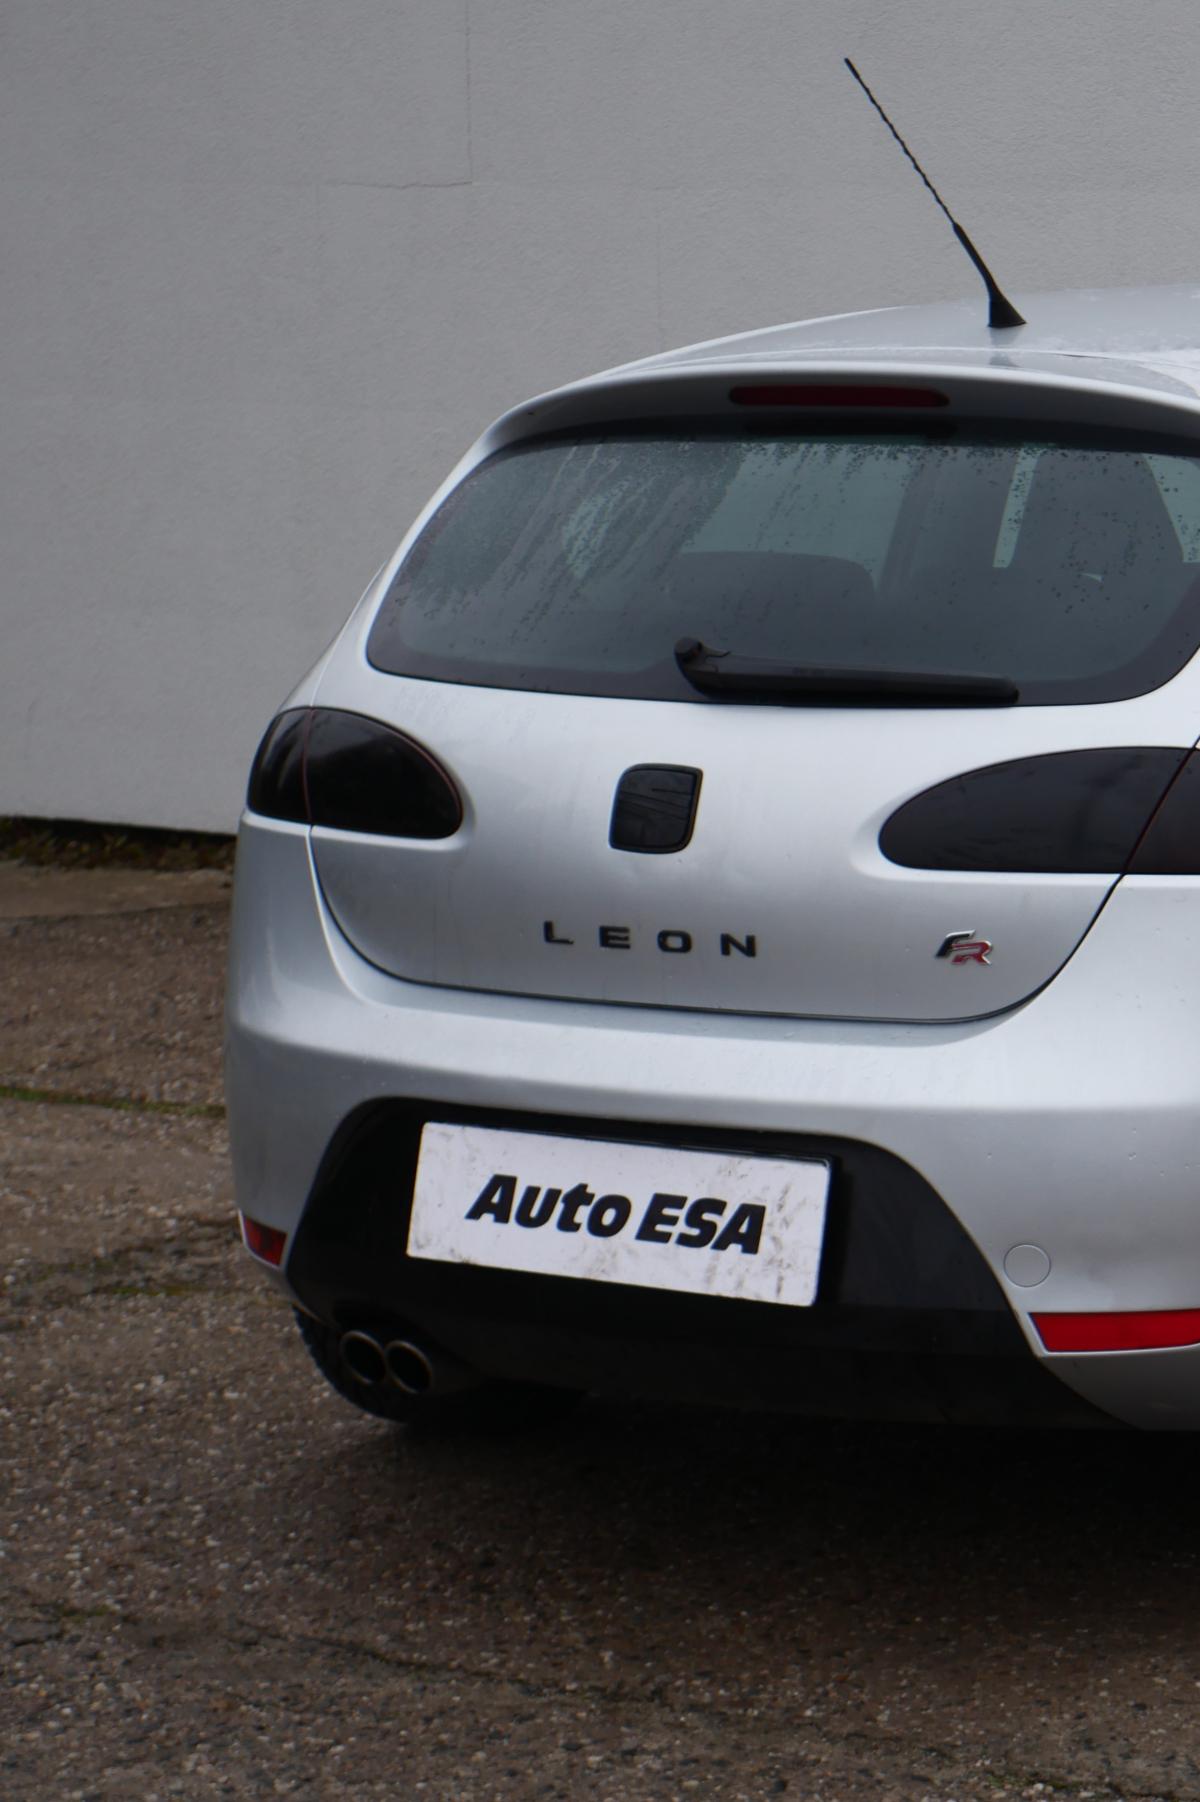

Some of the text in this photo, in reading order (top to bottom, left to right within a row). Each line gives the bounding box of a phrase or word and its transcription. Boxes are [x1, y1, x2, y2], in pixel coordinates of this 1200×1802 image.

[544, 920, 757, 957] LEON
[935, 929, 993, 965] FR
[465, 1174, 767, 1255] Auto ESA
